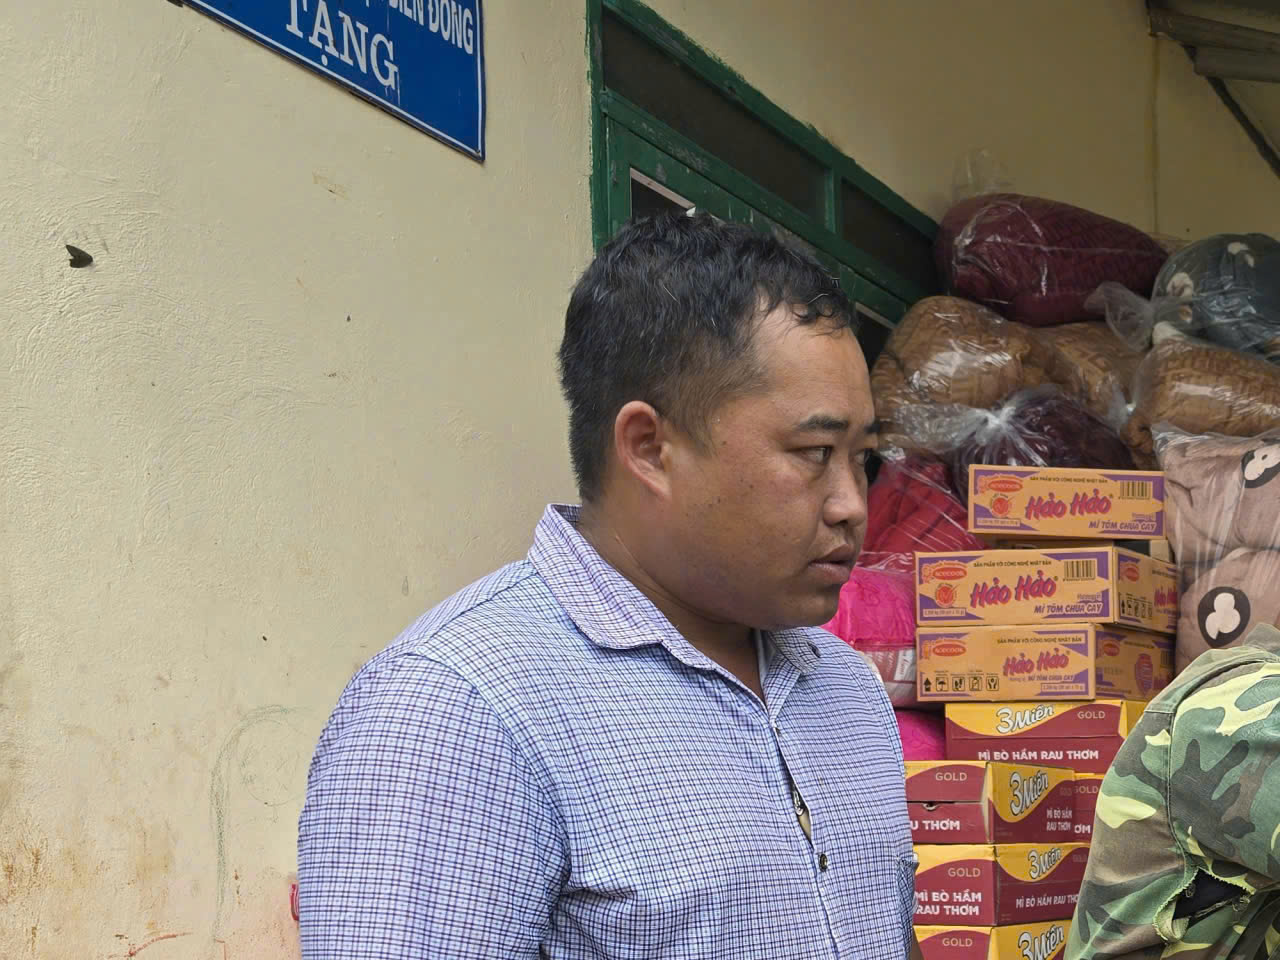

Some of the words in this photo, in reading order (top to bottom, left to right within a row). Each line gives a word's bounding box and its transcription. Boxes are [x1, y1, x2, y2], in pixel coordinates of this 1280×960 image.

[1025, 492, 1067, 520] Hảo
[1070, 488, 1112, 516] Hảo
[970, 577, 1012, 608] Hảo
[1015, 570, 1057, 601] Hảo
[1003, 653, 1035, 677] Hảo
[1037, 648, 1069, 671] Hảo
[1077, 710, 1105, 719] GOLD
[978, 750, 990, 760] MÌ
[994, 750, 1009, 760] BÒ
[1040, 751, 1063, 760] RAU
[1067, 750, 1099, 760] THƠM
[935, 772, 967, 781] GOLD
[922, 819, 960, 830] THƠM
[948, 868, 980, 878] GOLD
[932, 889, 949, 902] BÒ
[916, 905, 940, 915] RAU
[944, 904, 979, 915] THƠM
[942, 938, 973, 947] GOLD
